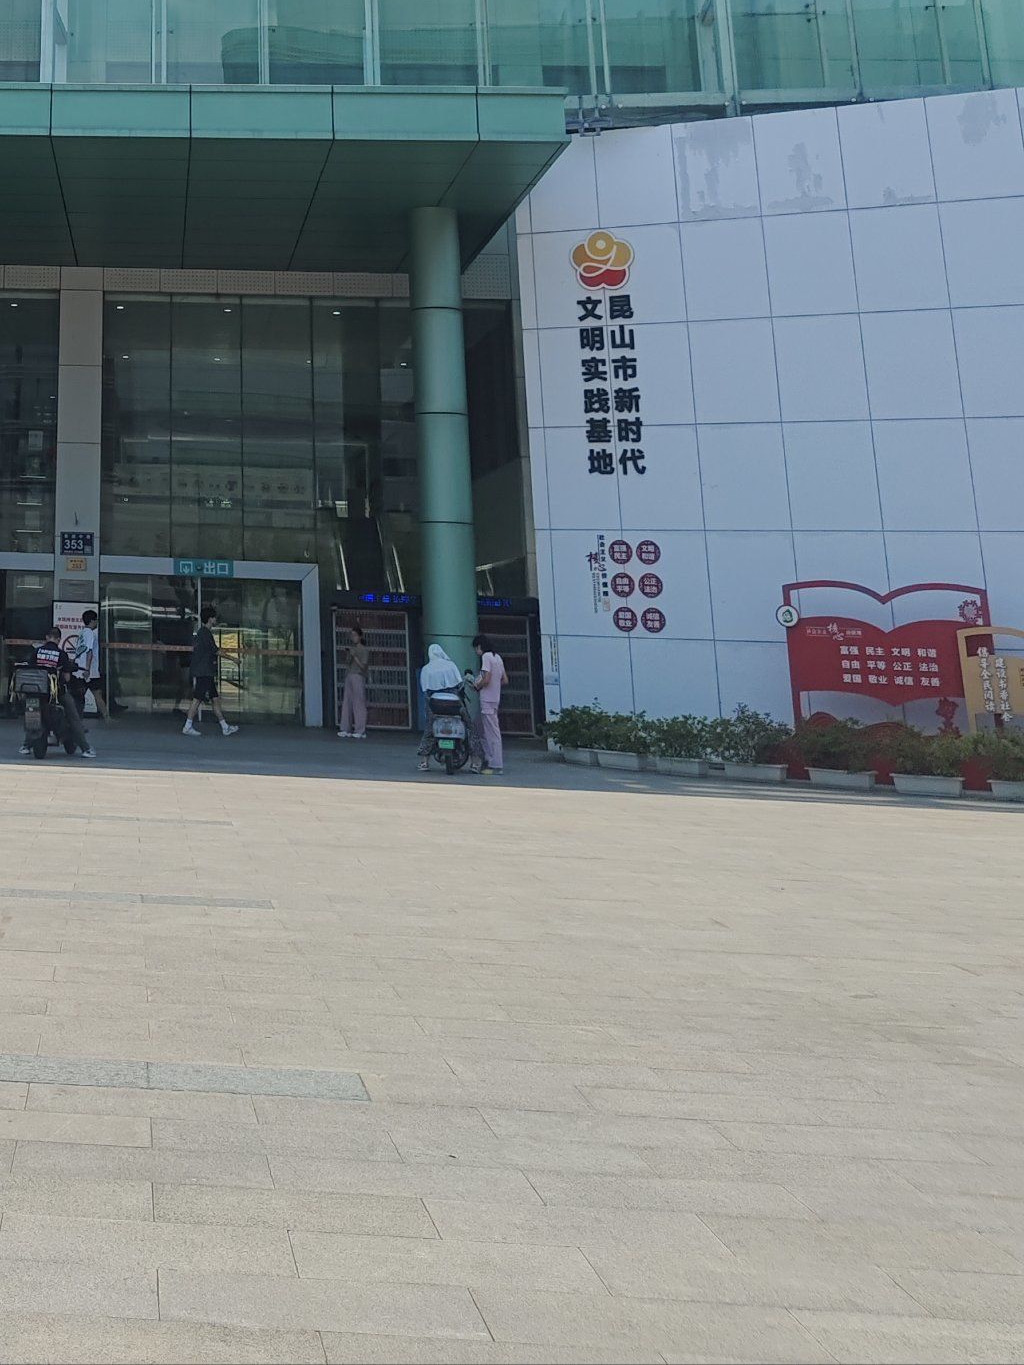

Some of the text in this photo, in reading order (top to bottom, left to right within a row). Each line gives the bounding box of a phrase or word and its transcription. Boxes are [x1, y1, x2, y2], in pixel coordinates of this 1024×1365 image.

[576, 296, 615, 475] 文明实践基地
[609, 294, 647, 476] 昆山市新时代
[64, 539, 84, 550] 353
[203, 560, 229, 575] 出口
[865, 646, 885, 656] 民主
[891, 647, 911, 657] 文明
[917, 648, 936, 658] 和谐
[841, 660, 939, 672] 自由 平等 公正 法治
[868, 674, 888, 684] 敬业
[894, 675, 914, 686] 诚信
